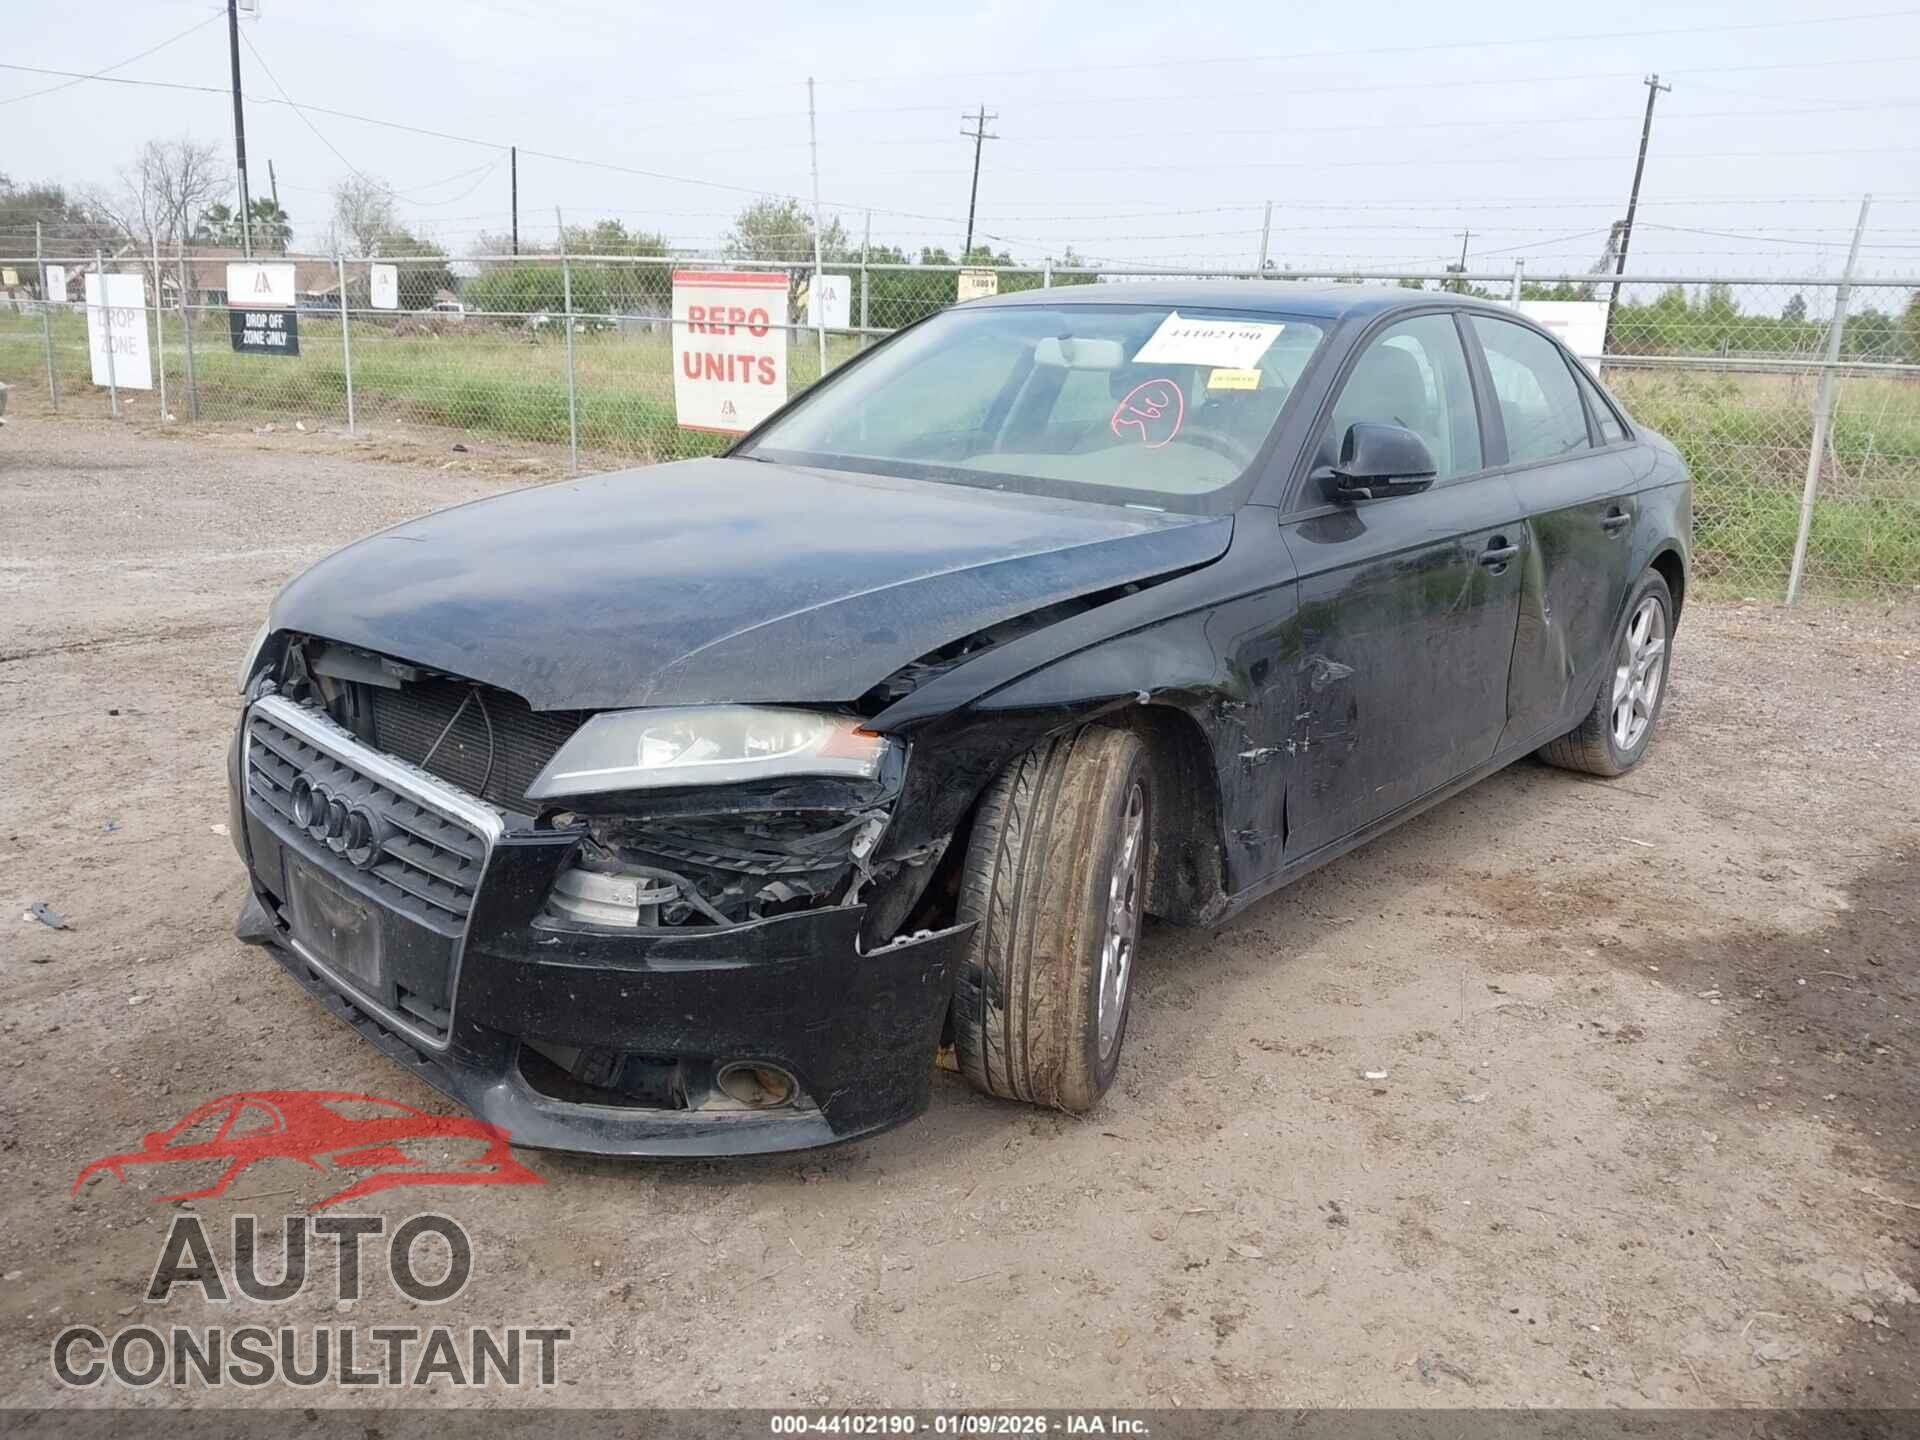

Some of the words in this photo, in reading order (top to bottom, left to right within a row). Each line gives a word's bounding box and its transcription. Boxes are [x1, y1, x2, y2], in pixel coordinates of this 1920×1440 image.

[245, 313, 267, 327] DROP
[268, 314, 284, 328] OFF
[687, 305, 770, 337] REPO
[242, 330, 265, 345] ZONE
[265, 331, 287, 346] ONLY
[683, 352, 776, 385] UNITS
